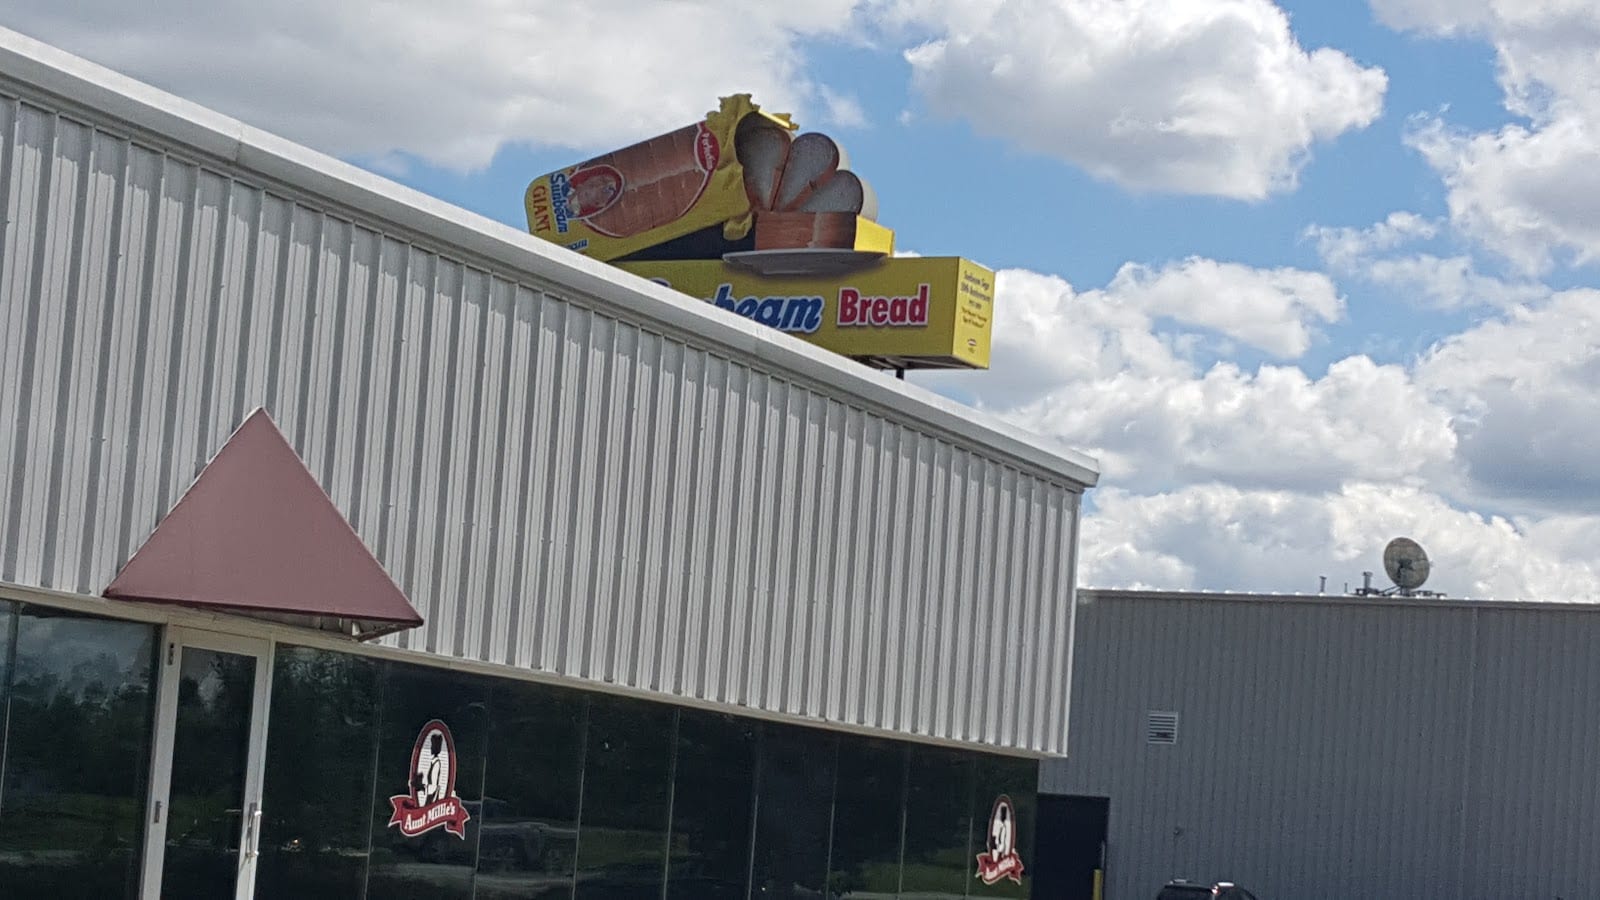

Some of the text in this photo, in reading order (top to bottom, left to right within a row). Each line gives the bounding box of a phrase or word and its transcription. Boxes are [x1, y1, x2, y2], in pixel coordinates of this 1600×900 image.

[532, 184, 551, 232] GIANT
[550, 172, 568, 233] Sunbeam
[650, 278, 824, 332] beam
[837, 284, 930, 326] Bread
[404, 802, 455, 830] Aunt Millie's
